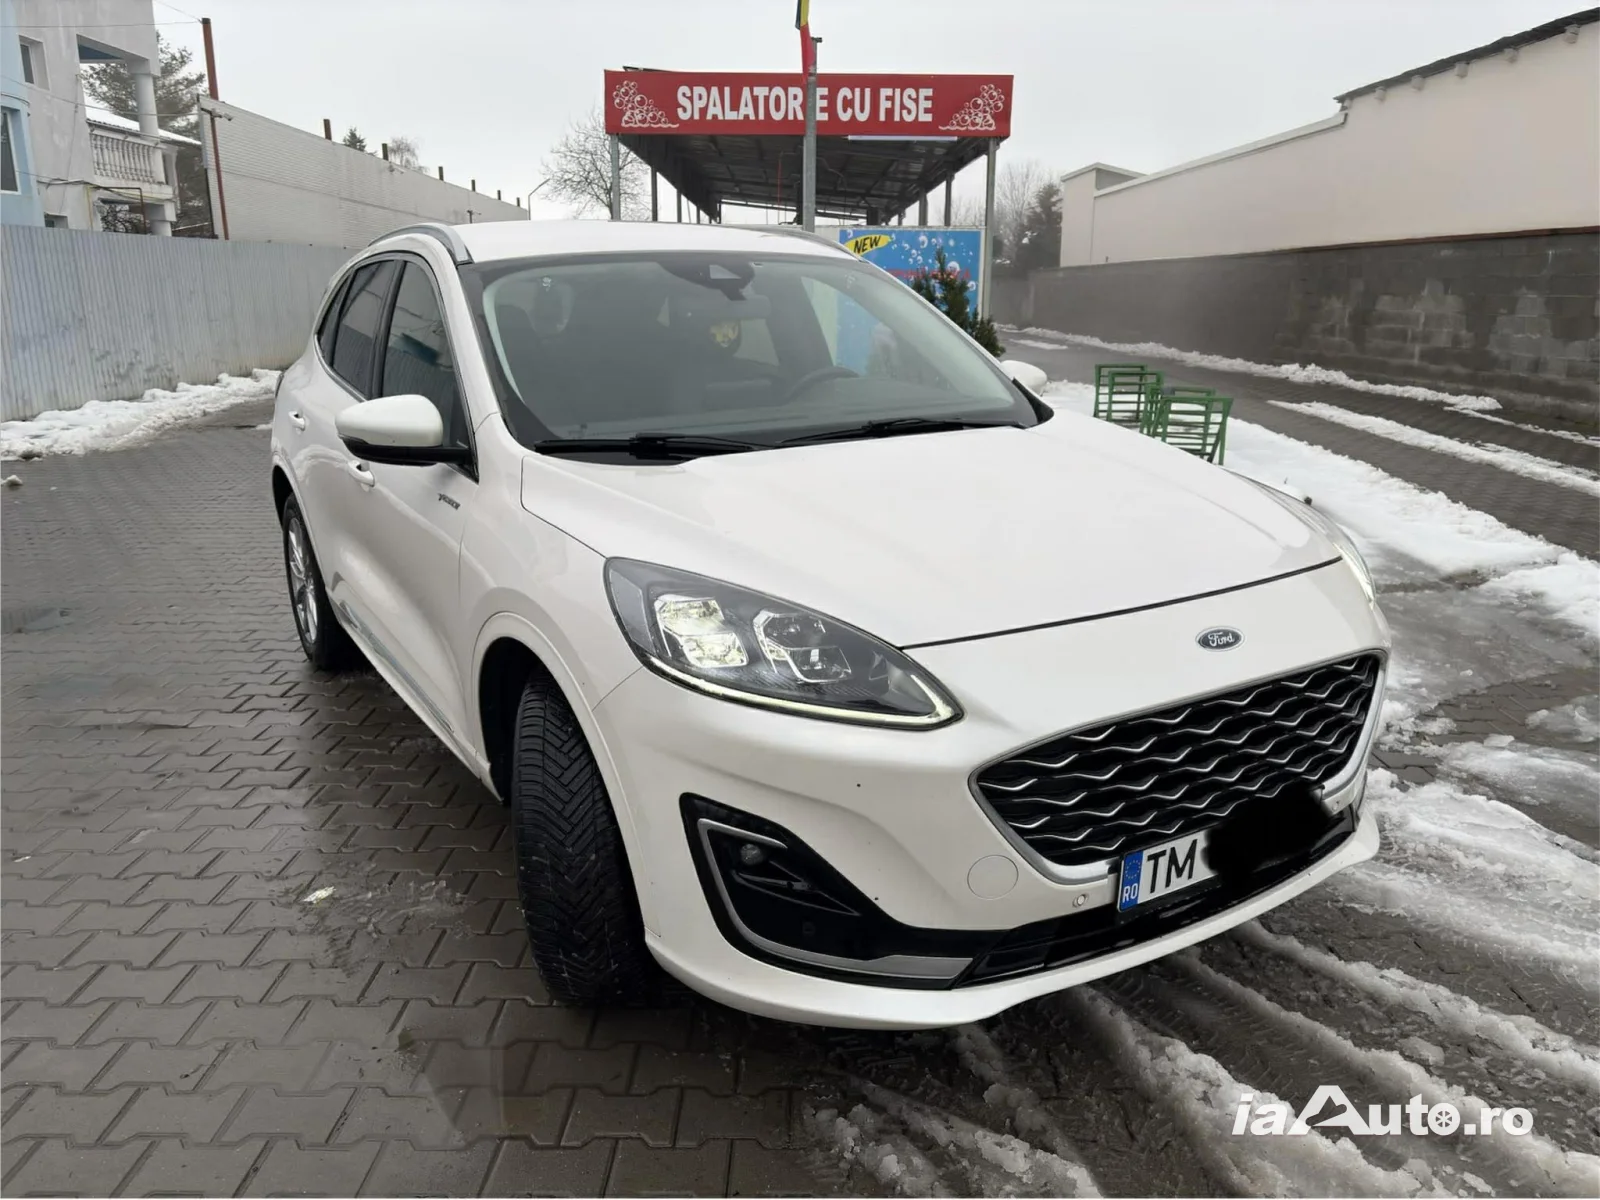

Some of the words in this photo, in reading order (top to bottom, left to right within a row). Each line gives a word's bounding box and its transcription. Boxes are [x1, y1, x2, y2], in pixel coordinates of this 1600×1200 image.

[677, 86, 829, 121] SPALATORE
[836, 87, 871, 122] CU
[879, 88, 933, 122] FISE
[853, 235, 881, 253] NEW
[1207, 631, 1236, 647] Ford
[1146, 838, 1198, 894] TM
[1122, 883, 1139, 904] RO
